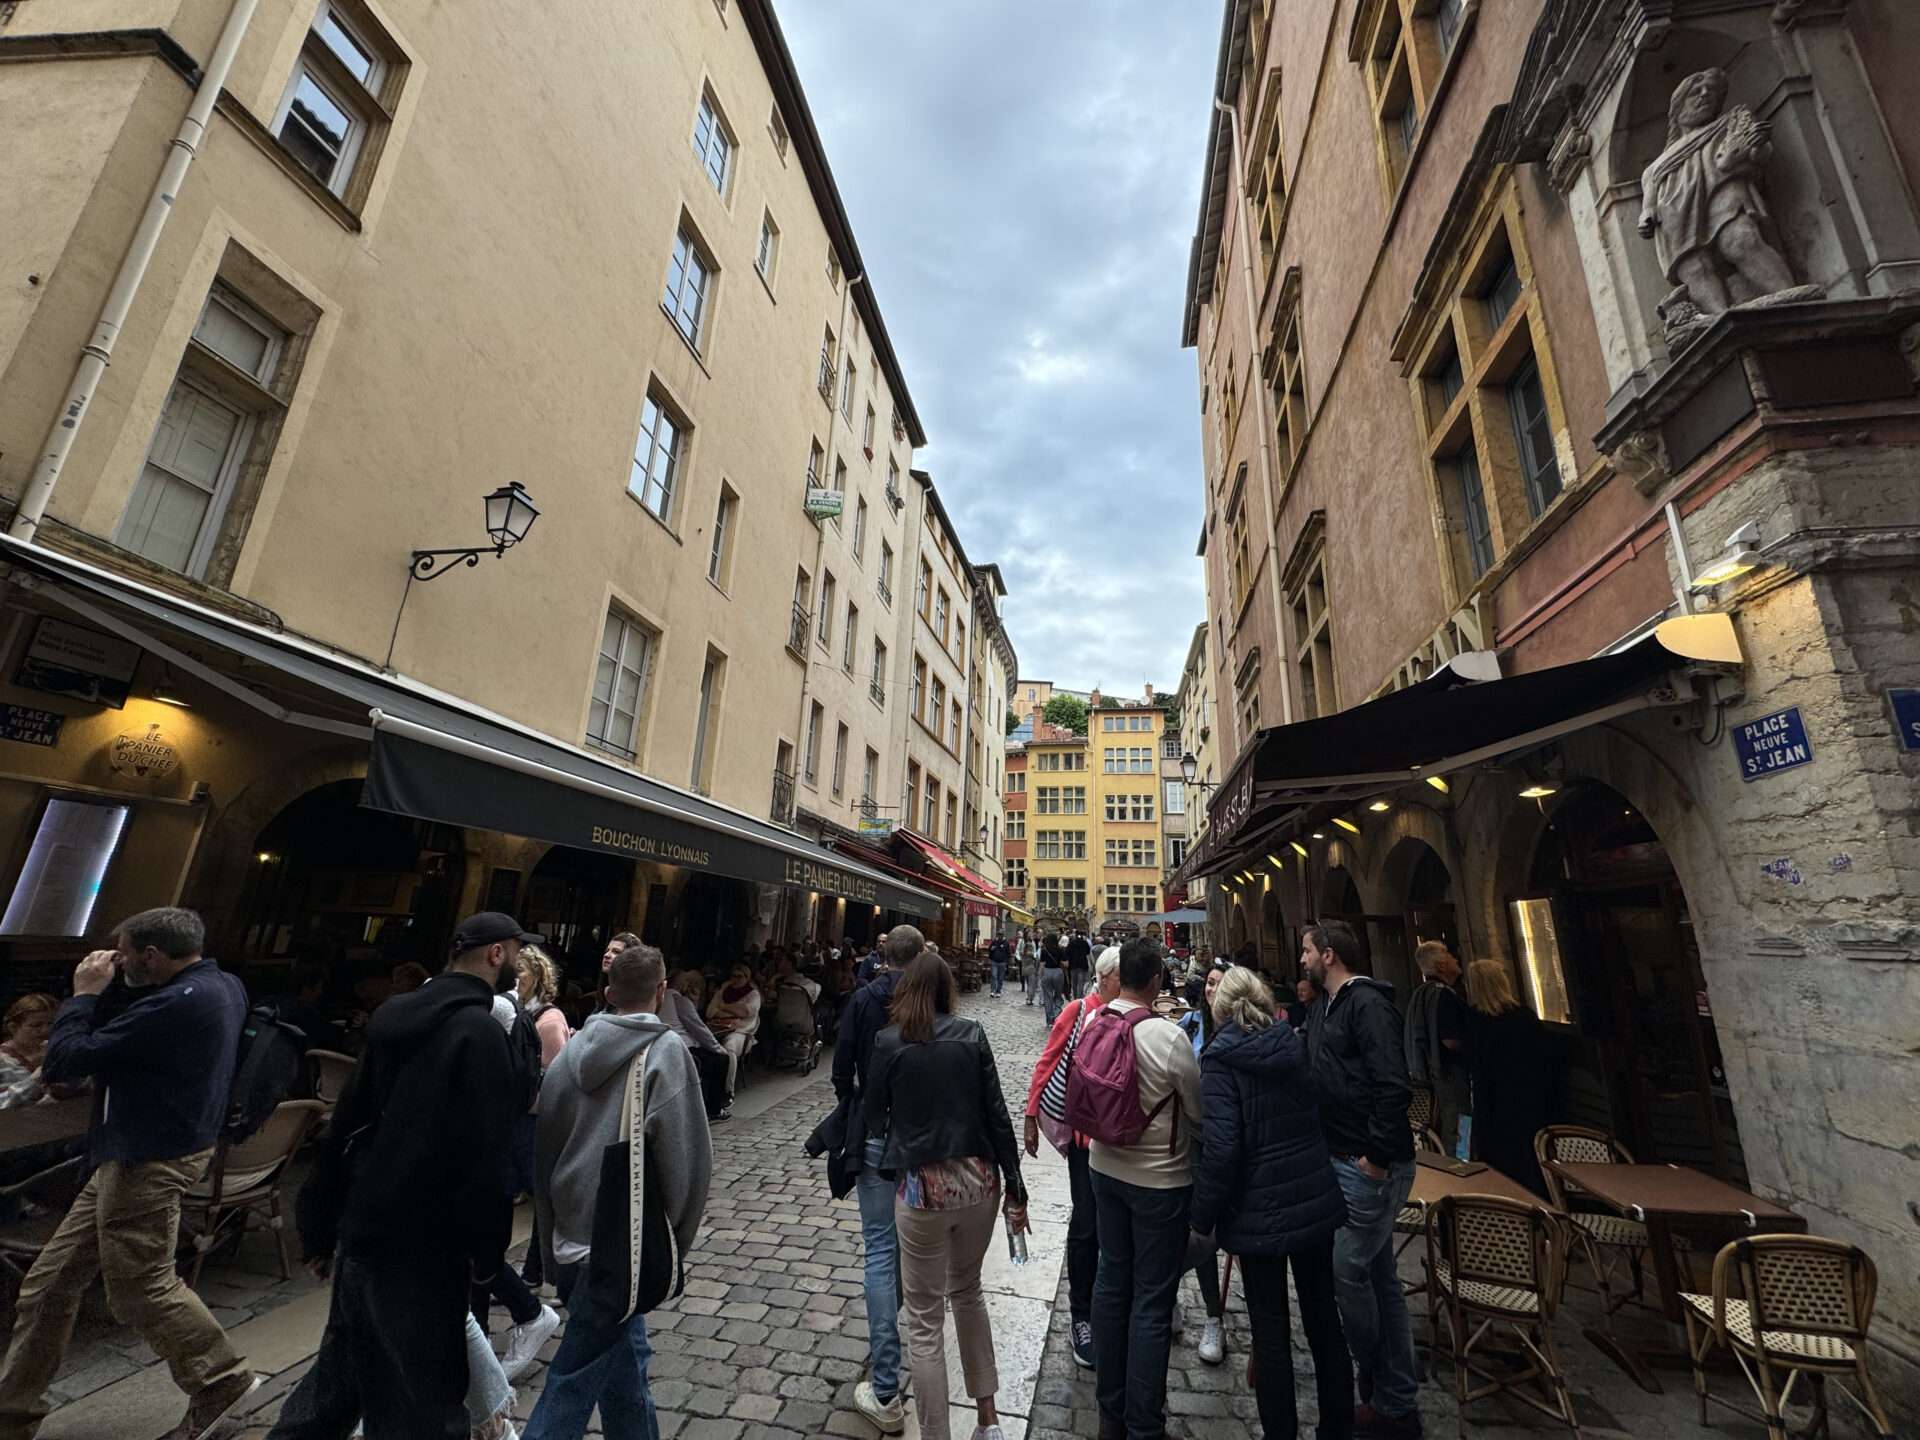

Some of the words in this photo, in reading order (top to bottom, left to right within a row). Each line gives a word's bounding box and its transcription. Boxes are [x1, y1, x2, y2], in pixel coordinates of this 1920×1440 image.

[8, 706, 52, 722] PLACE
[9, 716, 47, 731] NEUVE
[14, 729, 53, 746] JEAN
[145, 732, 162, 743] LE
[1744, 714, 1789, 740] PLACE
[127, 741, 173, 757] PANIER
[1753, 732, 1788, 753] NEUVE
[117, 752, 137, 763] DU
[139, 753, 174, 769] CHEF
[1766, 744, 1806, 768] JEAN
[592, 826, 656, 853] BOUCHON
[660, 842, 709, 865] LYONNAIS
[784, 858, 801, 884] LE
[803, 863, 841, 893] PANIER
[842, 874, 856, 897] DU
[856, 879, 877, 902] CHEF
[634, 1061, 643, 1102] JIMMY
[633, 1112, 641, 1156] FAIRLY
[633, 1162, 641, 1206] JIMMY
